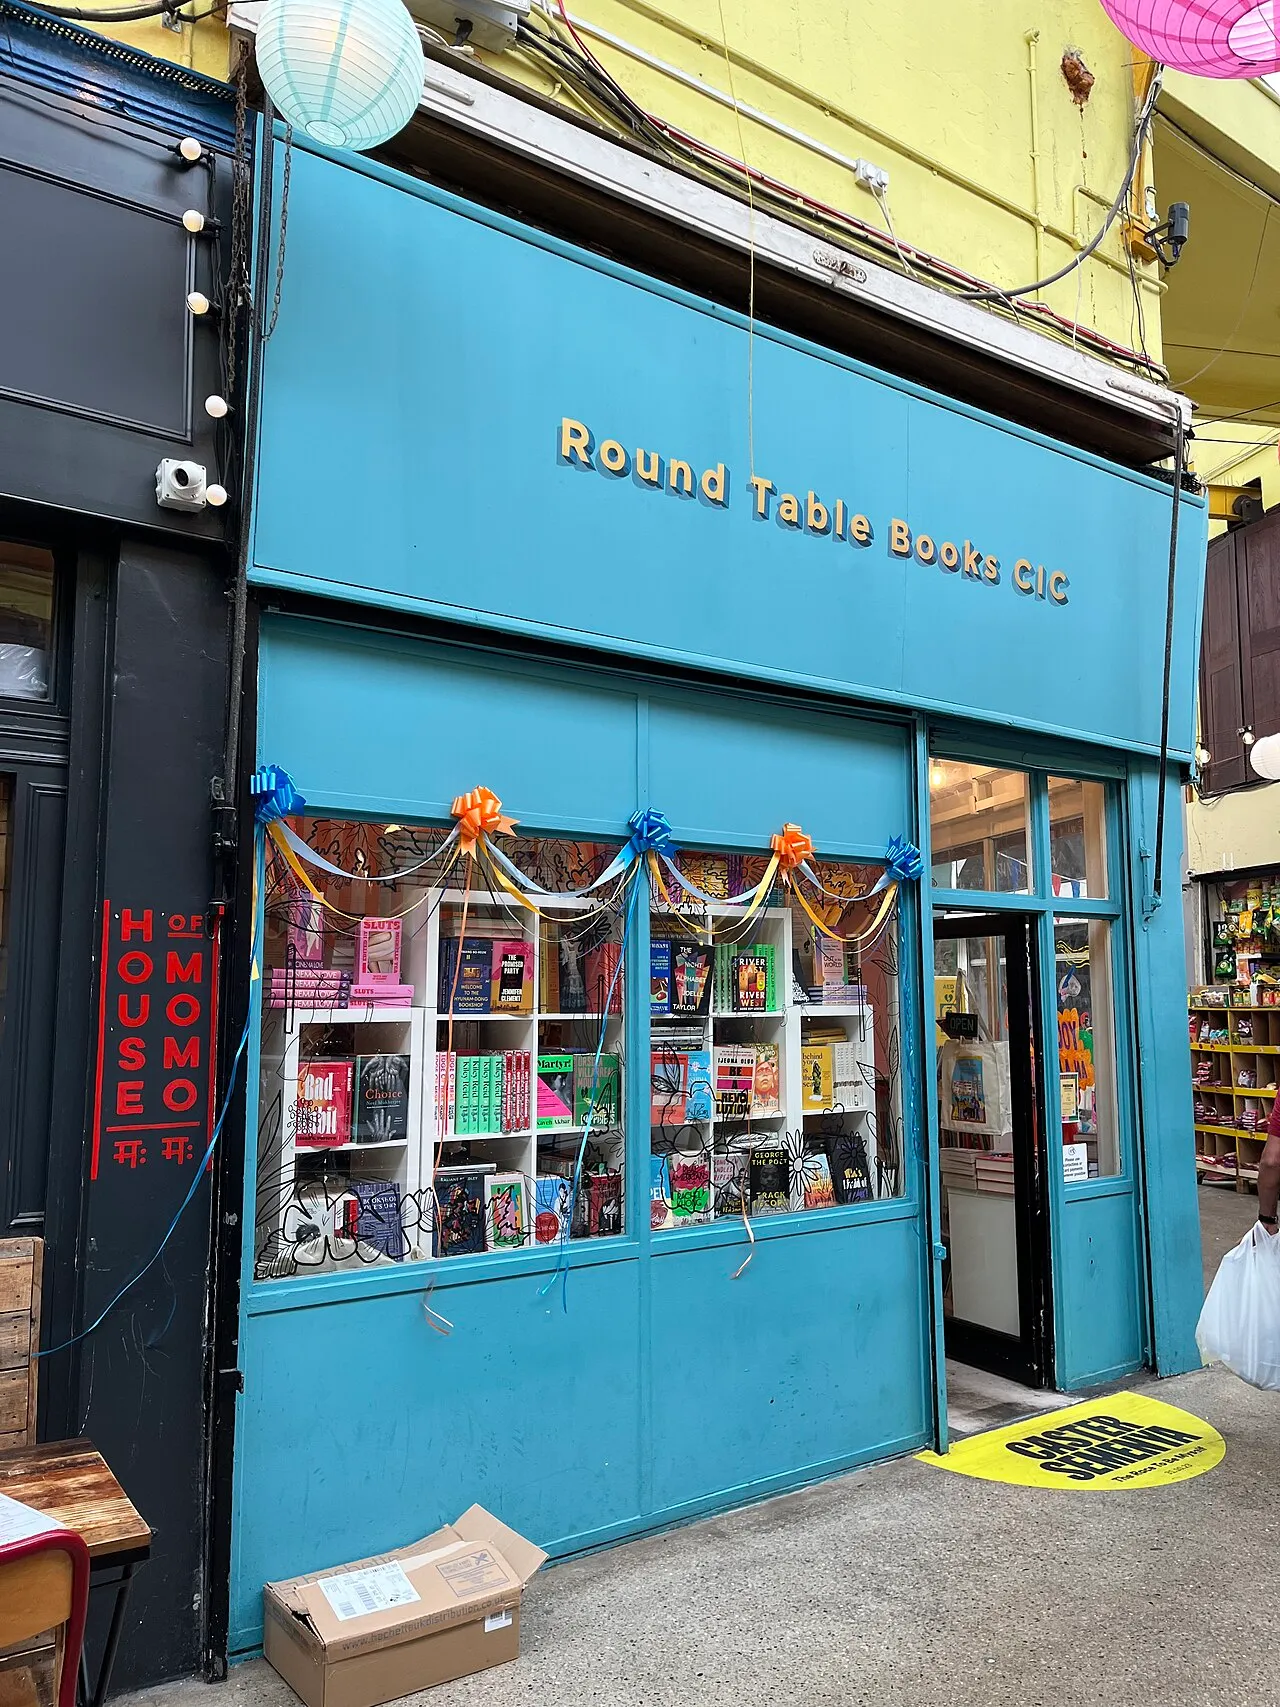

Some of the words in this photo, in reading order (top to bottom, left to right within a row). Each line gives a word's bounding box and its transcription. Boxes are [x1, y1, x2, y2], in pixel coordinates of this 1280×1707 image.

[559, 417, 728, 506] Round
[752, 477, 873, 545] Table
[890, 518, 1001, 584] Books
[1013, 559, 1069, 604] CIC
[168, 914, 203, 932] OF
[363, 920, 401, 930] SLUTS
[680, 946, 692, 954] THE
[685, 961, 703, 969] NIGHT
[739, 958, 766, 966] RIVER
[742, 966, 764, 974] EAST
[676, 975, 707, 983] ALPHABET
[682, 990, 705, 998] JOELLE
[739, 991, 766, 999] RIVER
[672, 1003, 696, 1011] TAYLOR
[741, 999, 765, 1007] WEST
[116, 908, 154, 1115] HOUSE
[950, 1017, 974, 1031] OPEN
[163, 951, 203, 1112] MOMO
[802, 1052, 823, 1060] behind
[461, 1061, 469, 1079] Kiley
[471, 1060, 479, 1079] Kiley
[482, 1061, 490, 1079] Kiley
[493, 1060, 502, 1078] Kiley
[538, 1060, 571, 1070] Martyr!
[729, 1066, 742, 1076] BE
[305, 1072, 334, 1101] Bad
[731, 1079, 738, 1089] A
[365, 1088, 403, 1100] Choice
[721, 1092, 747, 1103] REVO
[716, 1103, 750, 1114] LUTION
[754, 1151, 784, 1159] GEORGE
[756, 1191, 786, 1199] TRACK
[1005, 1415, 1145, 1460] CASTER
[1039, 1425, 1204, 1481] SEMENYA
[1111, 1474, 1134, 1482] The
[1129, 1466, 1157, 1476] Race
[1174, 1446, 1208, 1459] Myself
[342, 1596, 505, 1651] www.hachetteukdistribution.co.uk
